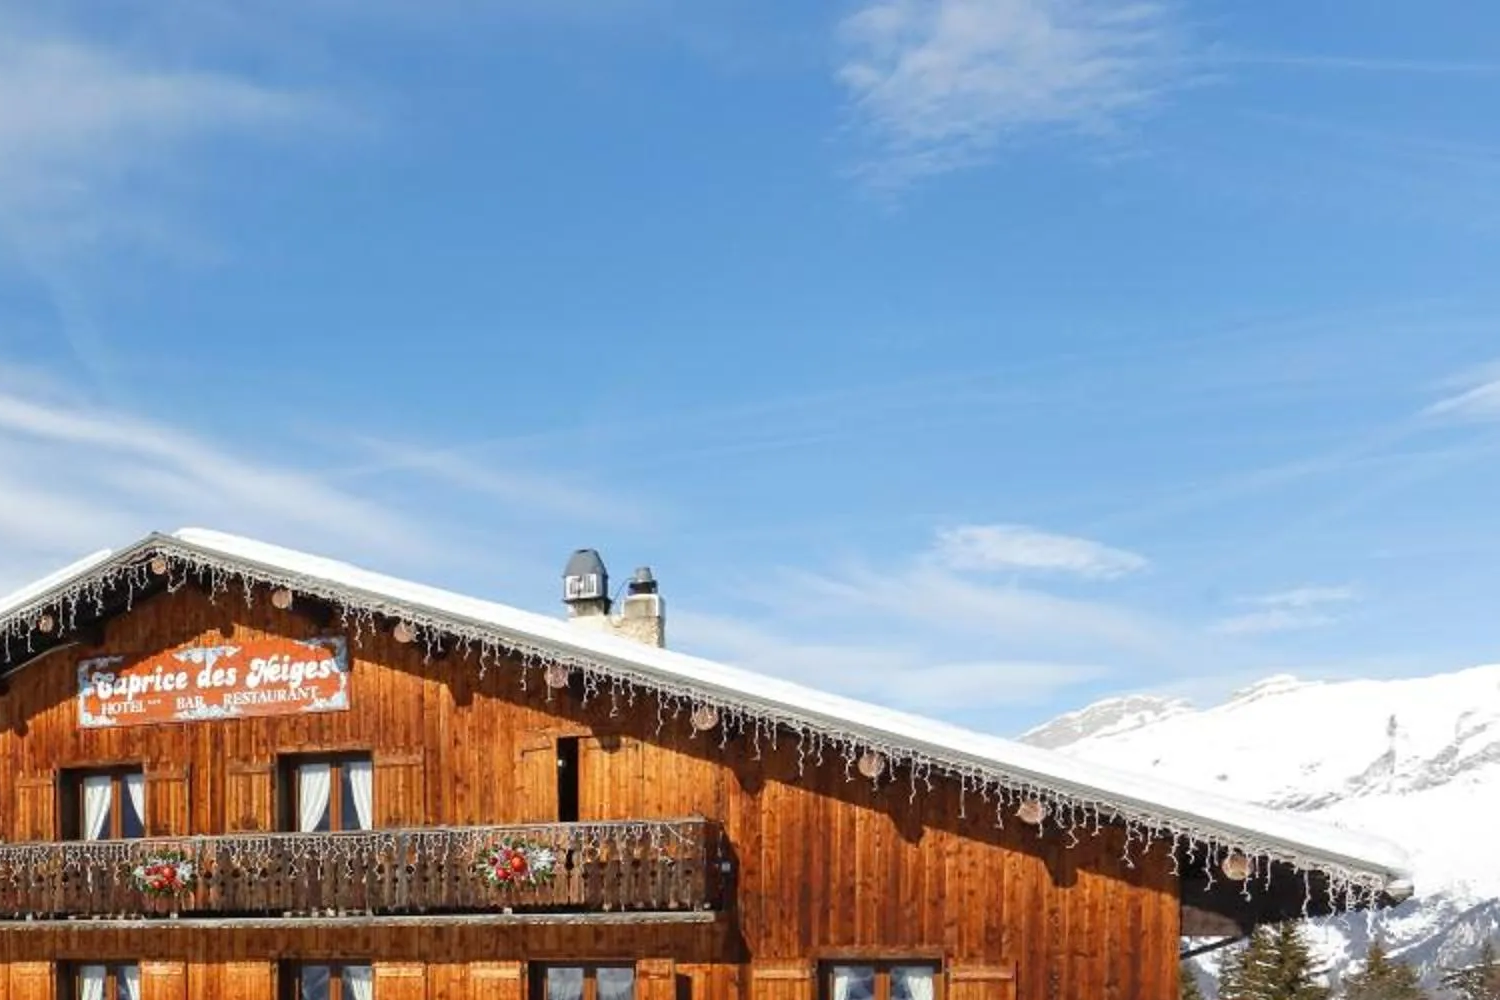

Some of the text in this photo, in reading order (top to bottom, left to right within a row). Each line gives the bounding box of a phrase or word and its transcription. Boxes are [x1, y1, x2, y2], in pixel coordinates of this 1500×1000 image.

[92, 654, 332, 701] Caprice des Neiges
[101, 685, 318, 715] HOTEL BAR RESTAURANT
